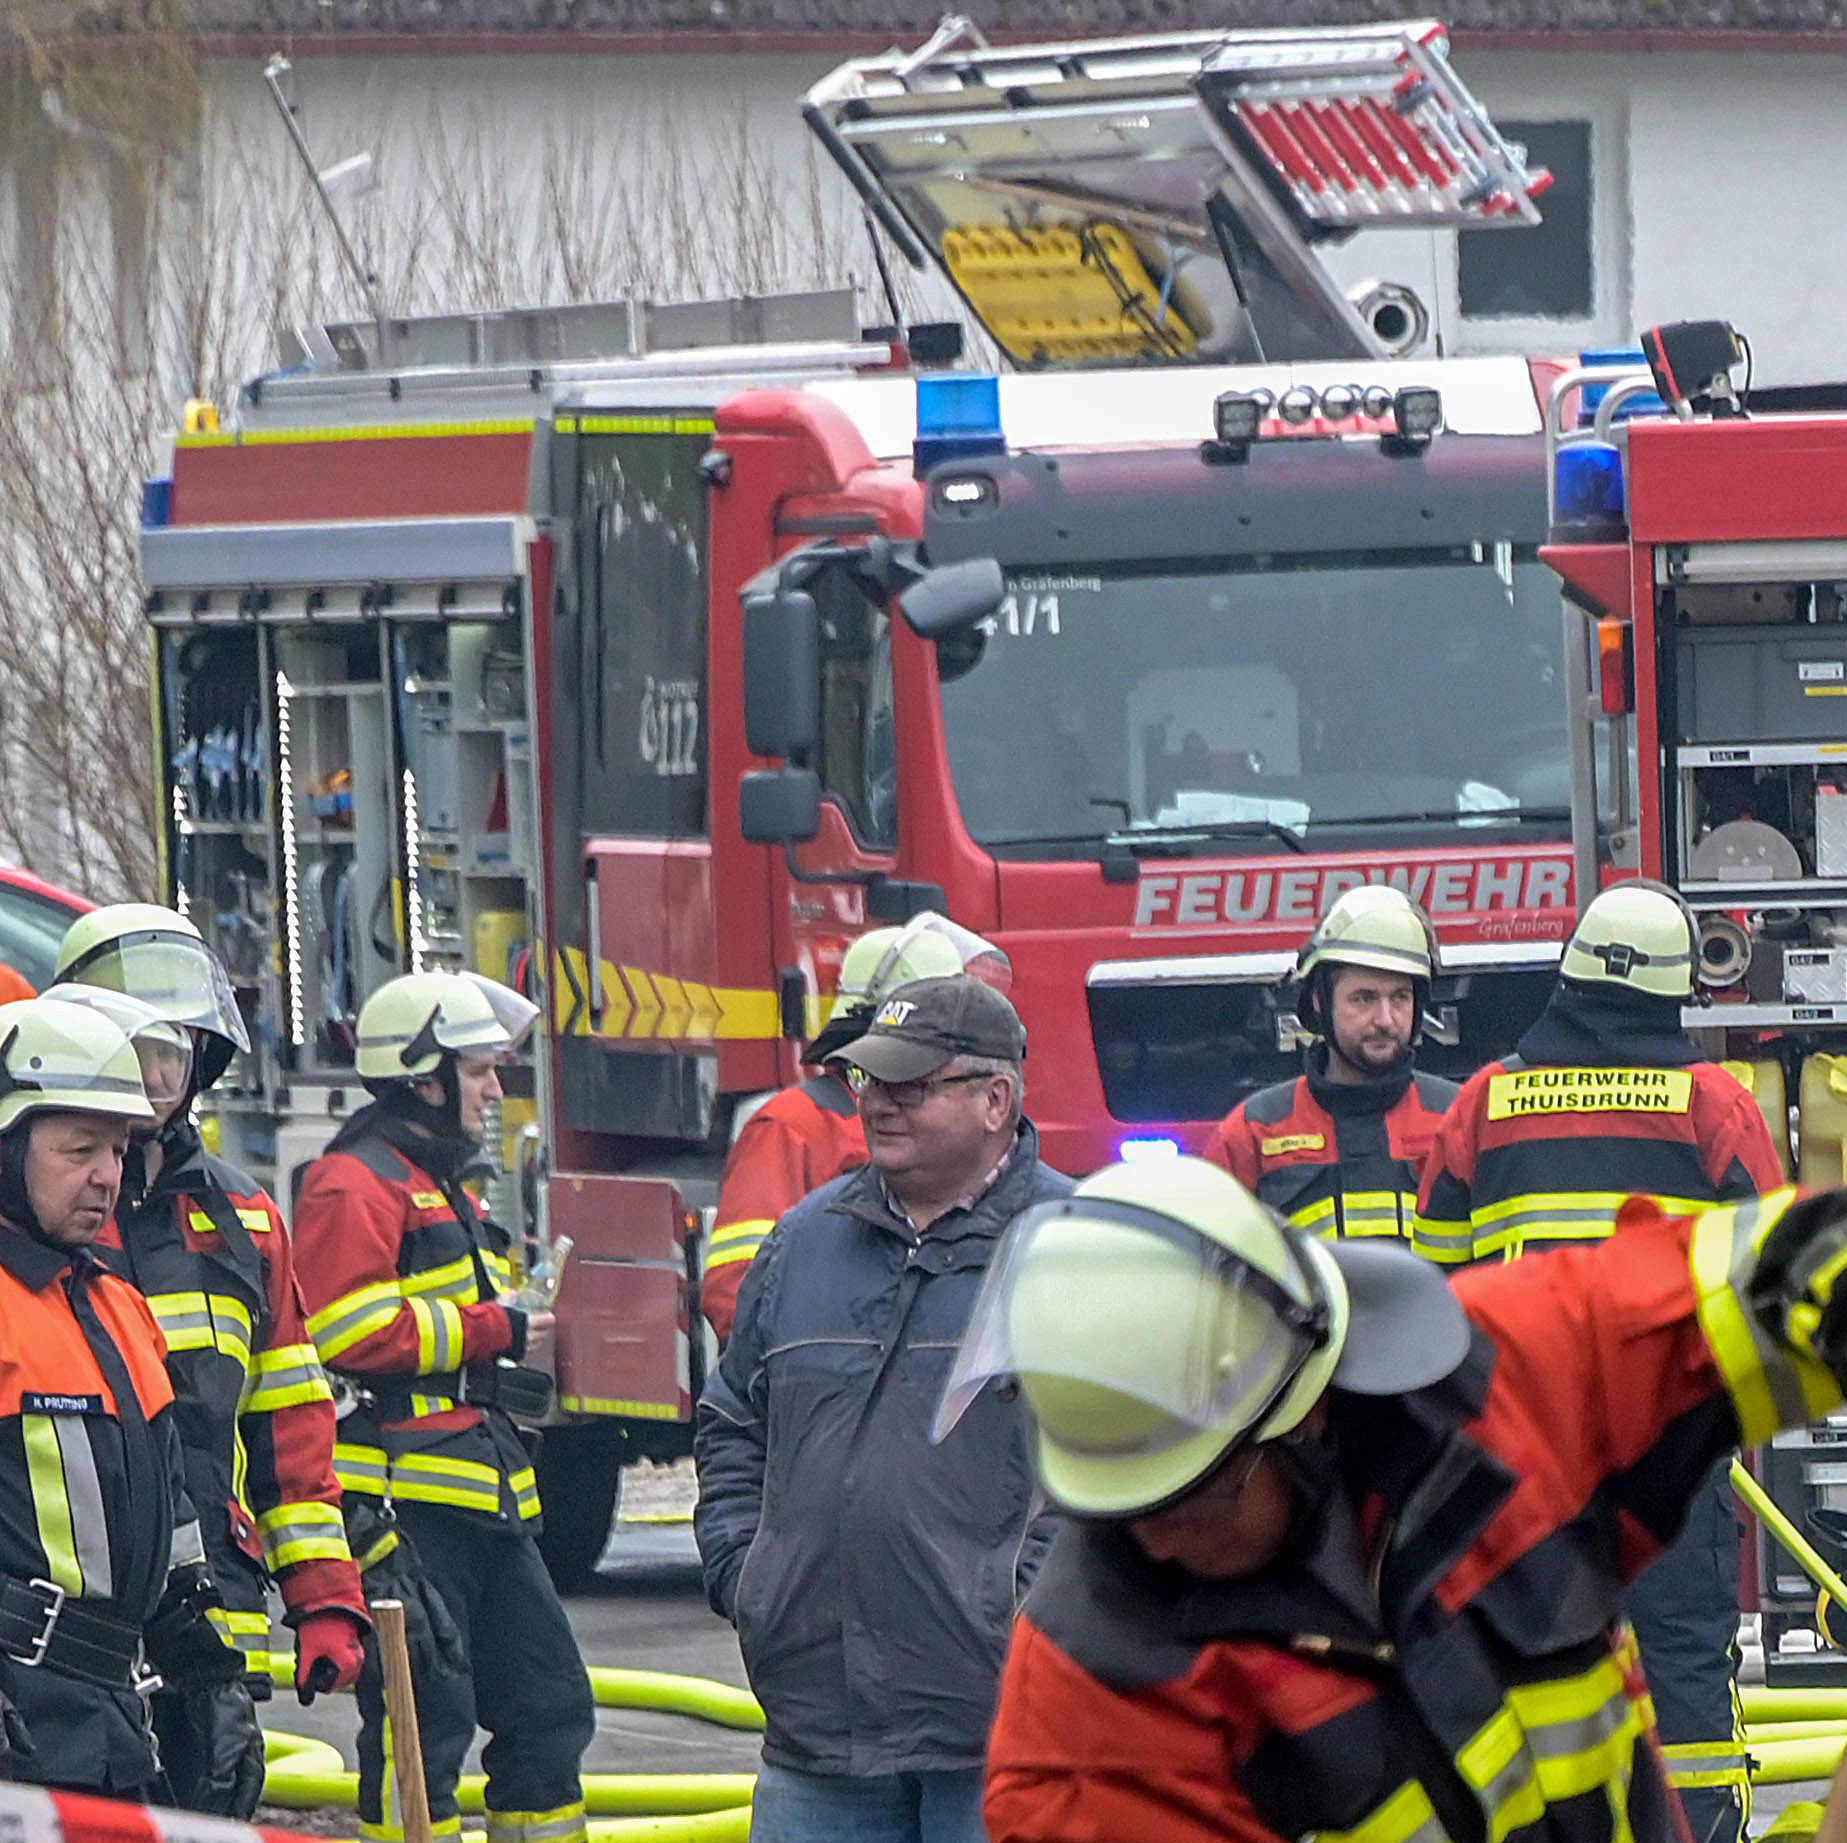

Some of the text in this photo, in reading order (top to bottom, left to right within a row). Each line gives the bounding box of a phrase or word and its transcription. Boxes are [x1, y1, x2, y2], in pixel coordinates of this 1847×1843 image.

[1135, 860, 1573, 925] FEUERWEHR
[1515, 1072, 1667, 1090] FEUERWEHR
[1507, 1092, 1670, 1113] THUISBRUNN
